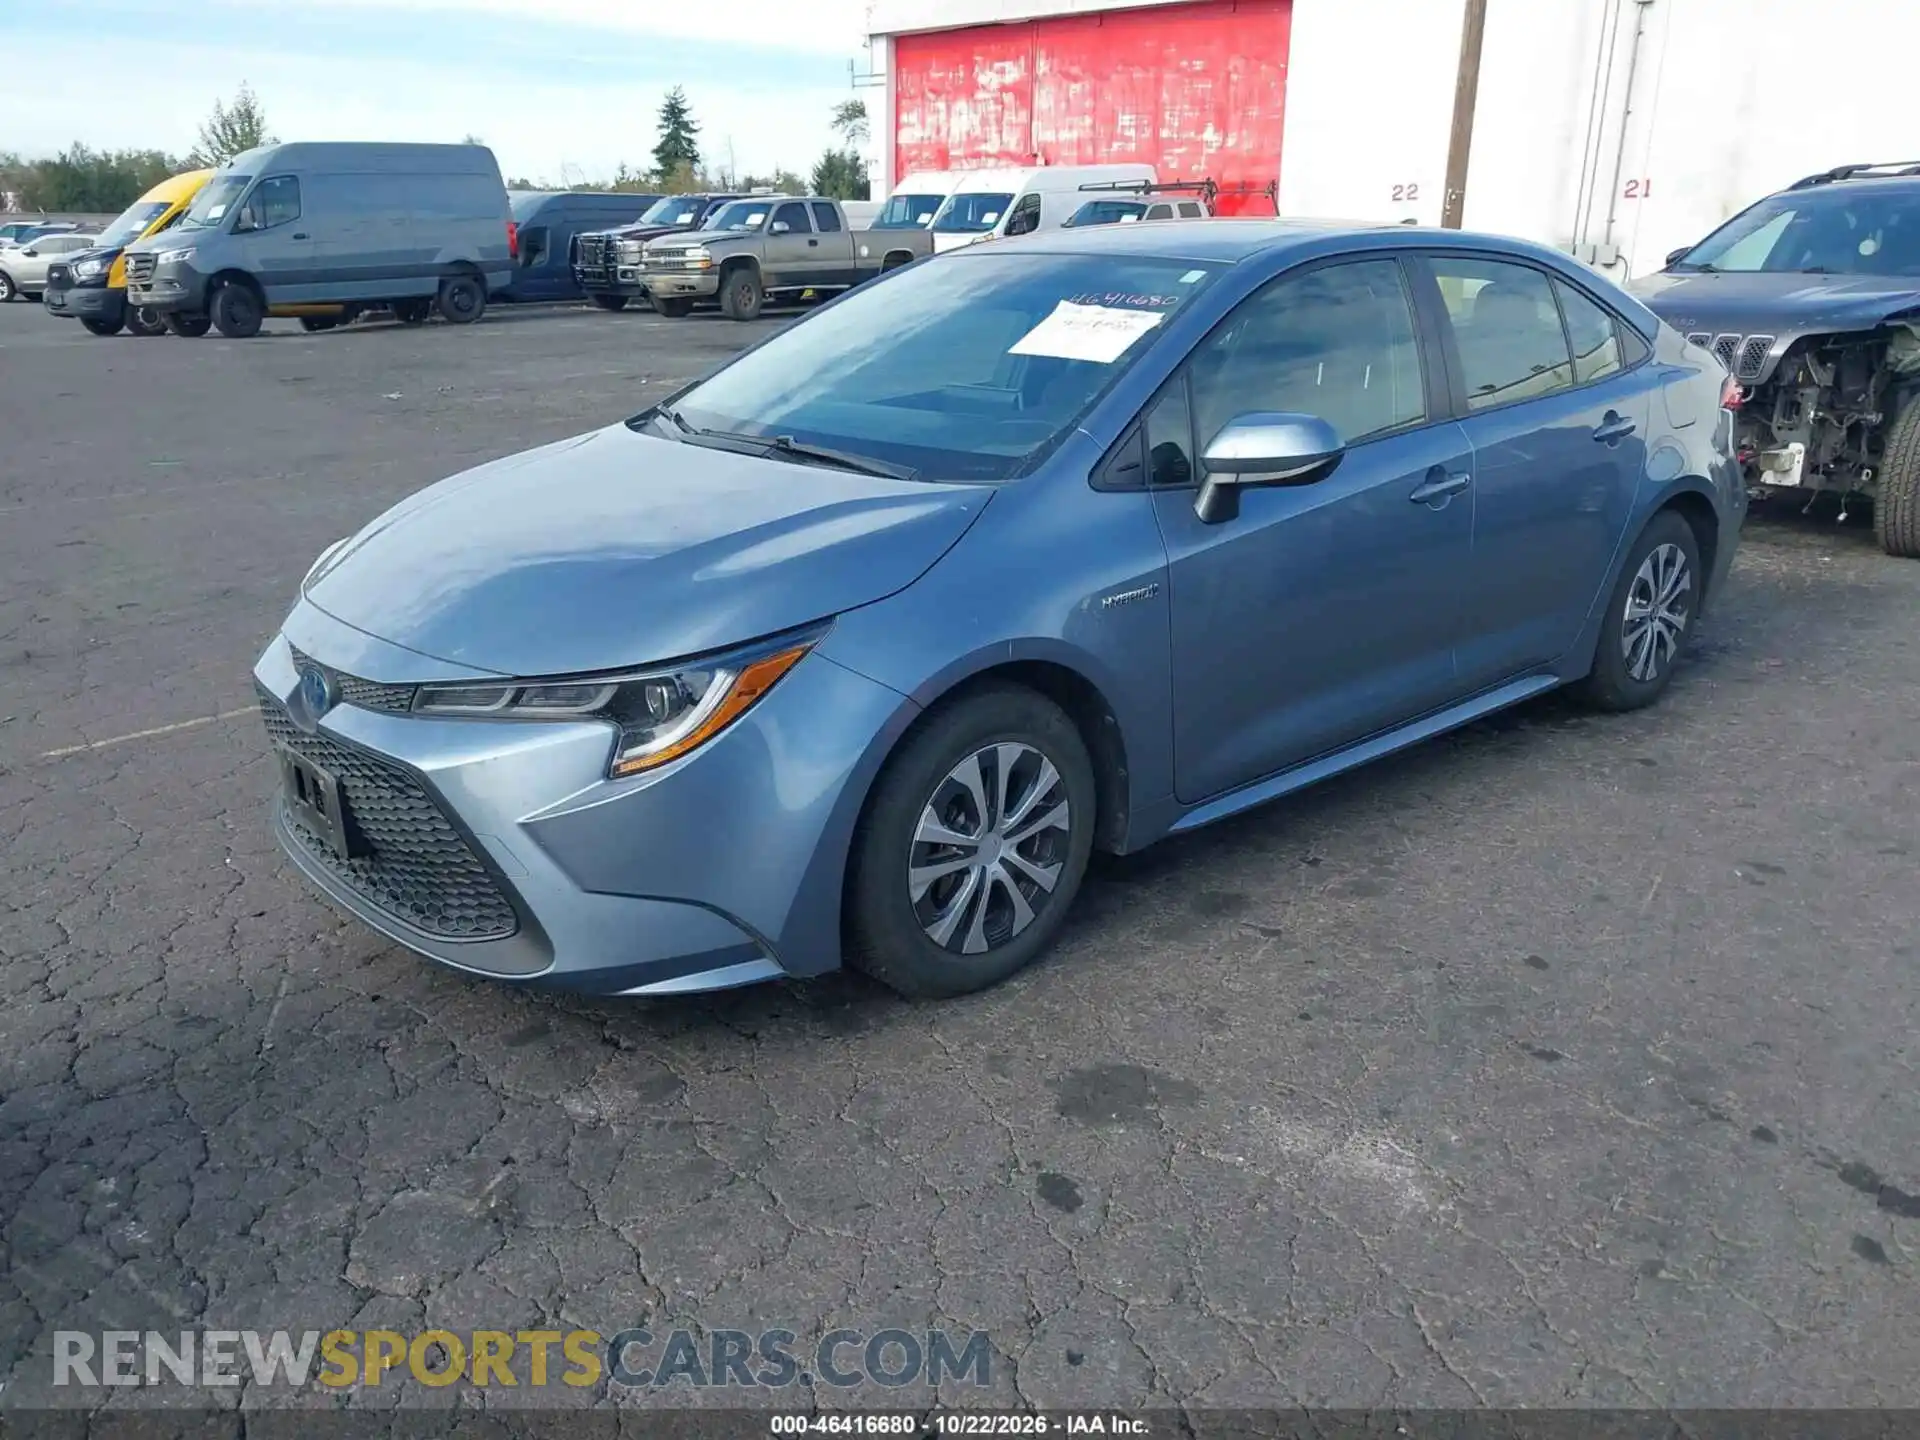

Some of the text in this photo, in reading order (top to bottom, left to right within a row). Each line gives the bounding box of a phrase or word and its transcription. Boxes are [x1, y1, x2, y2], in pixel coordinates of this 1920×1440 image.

[1391, 183, 1419, 201] 22
[1624, 178, 1651, 198] 21
[1101, 582, 1159, 609] HYBRID
